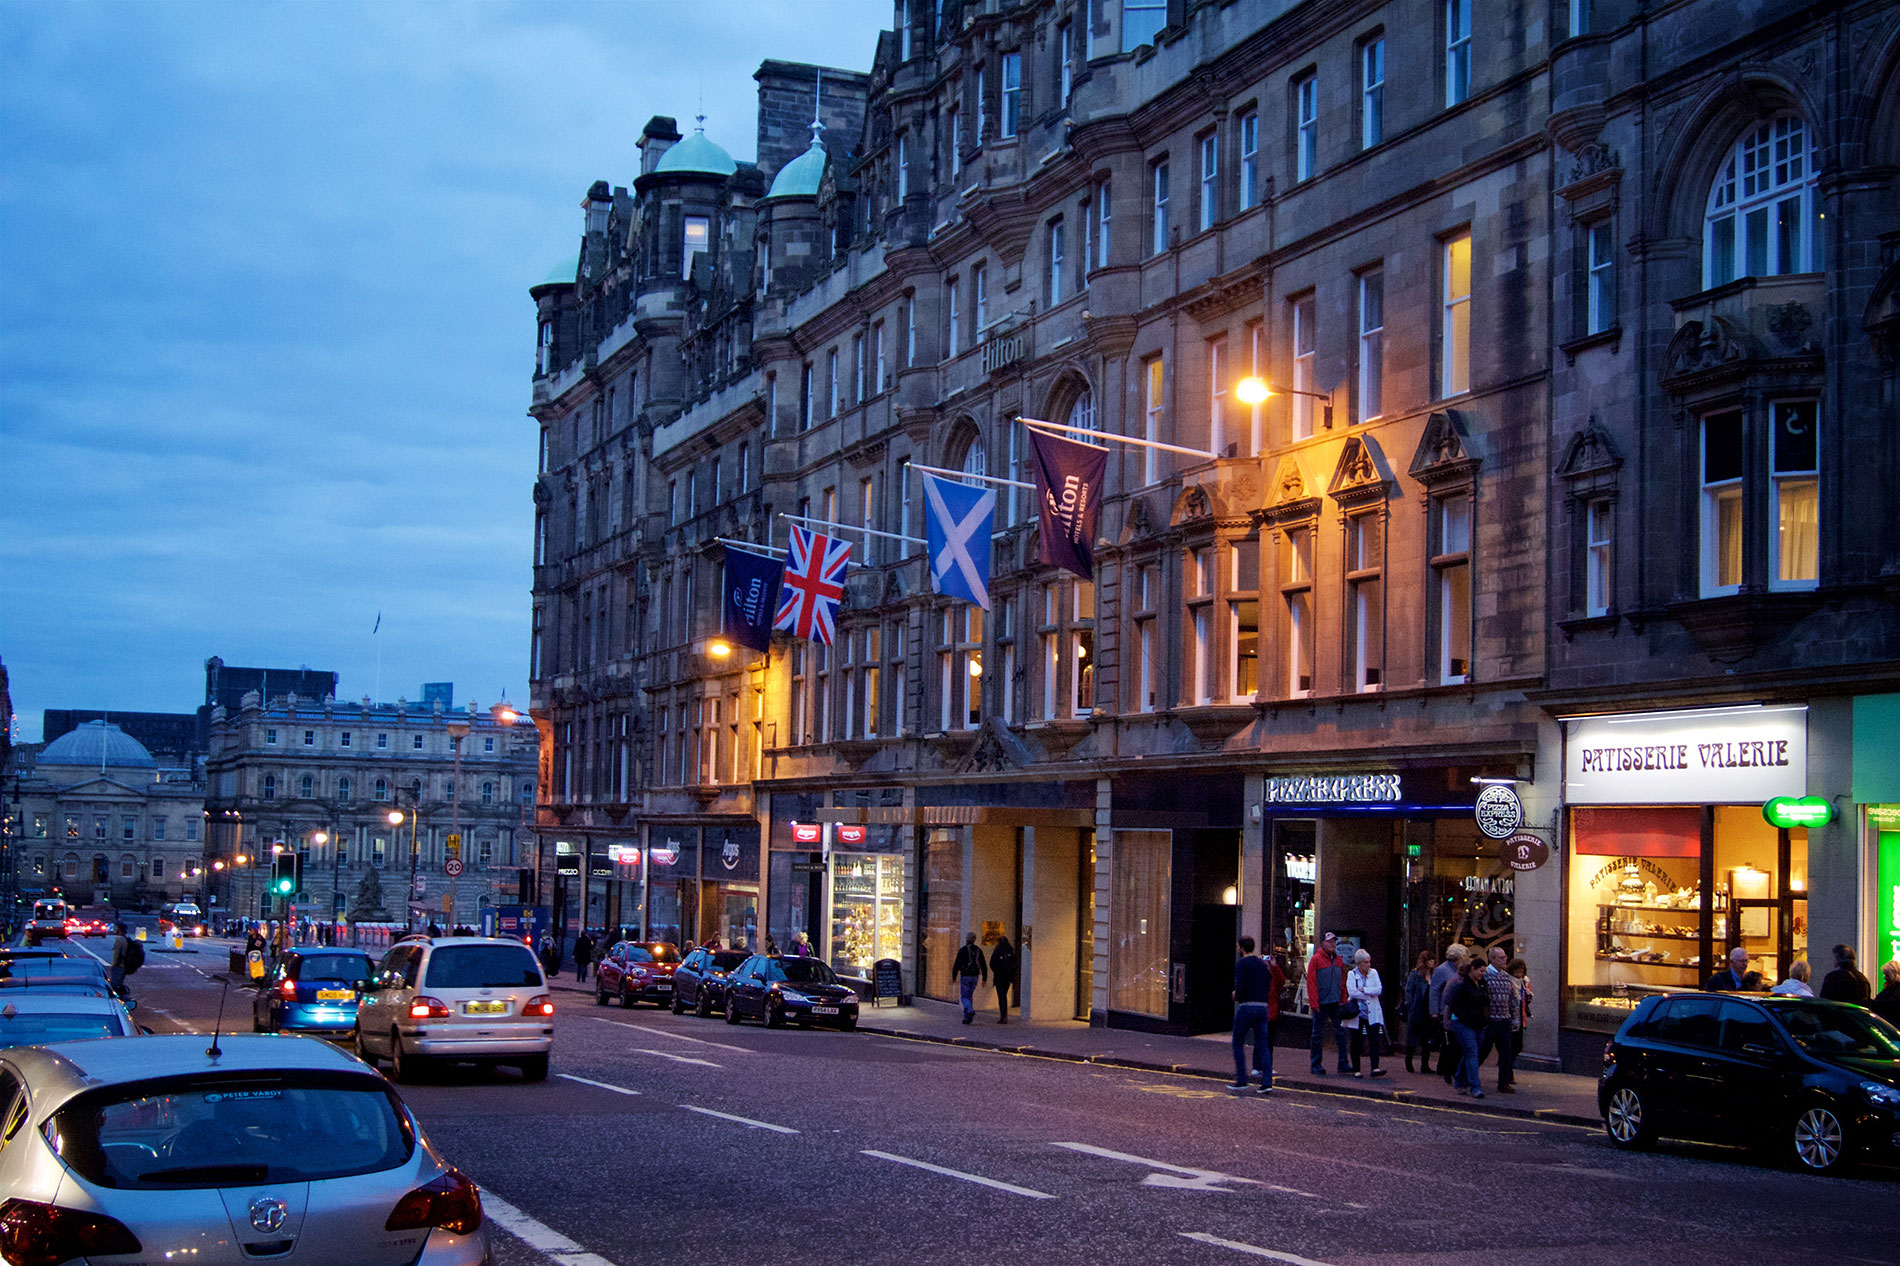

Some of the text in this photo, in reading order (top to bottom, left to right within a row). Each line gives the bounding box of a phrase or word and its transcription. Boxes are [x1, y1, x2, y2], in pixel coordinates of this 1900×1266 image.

[980, 336, 1024, 376] Hilton
[1079, 482, 1089, 512] RESORTS
[1059, 475, 1080, 538] ilton
[1581, 740, 1790, 773] PATISSERIE VALERIE
[1480, 810, 1516, 818] EXPRESS
[1487, 803, 1509, 811] PIZZA
[1505, 834, 1542, 847] PATISSERIE
[722, 839, 740, 861] Argos
[447, 863, 461, 871] 20
[1510, 860, 1537, 870] VALERIE
[1589, 856, 1677, 893] PATISSERIE VALERIE
[223, 1091, 249, 1099] PETER
